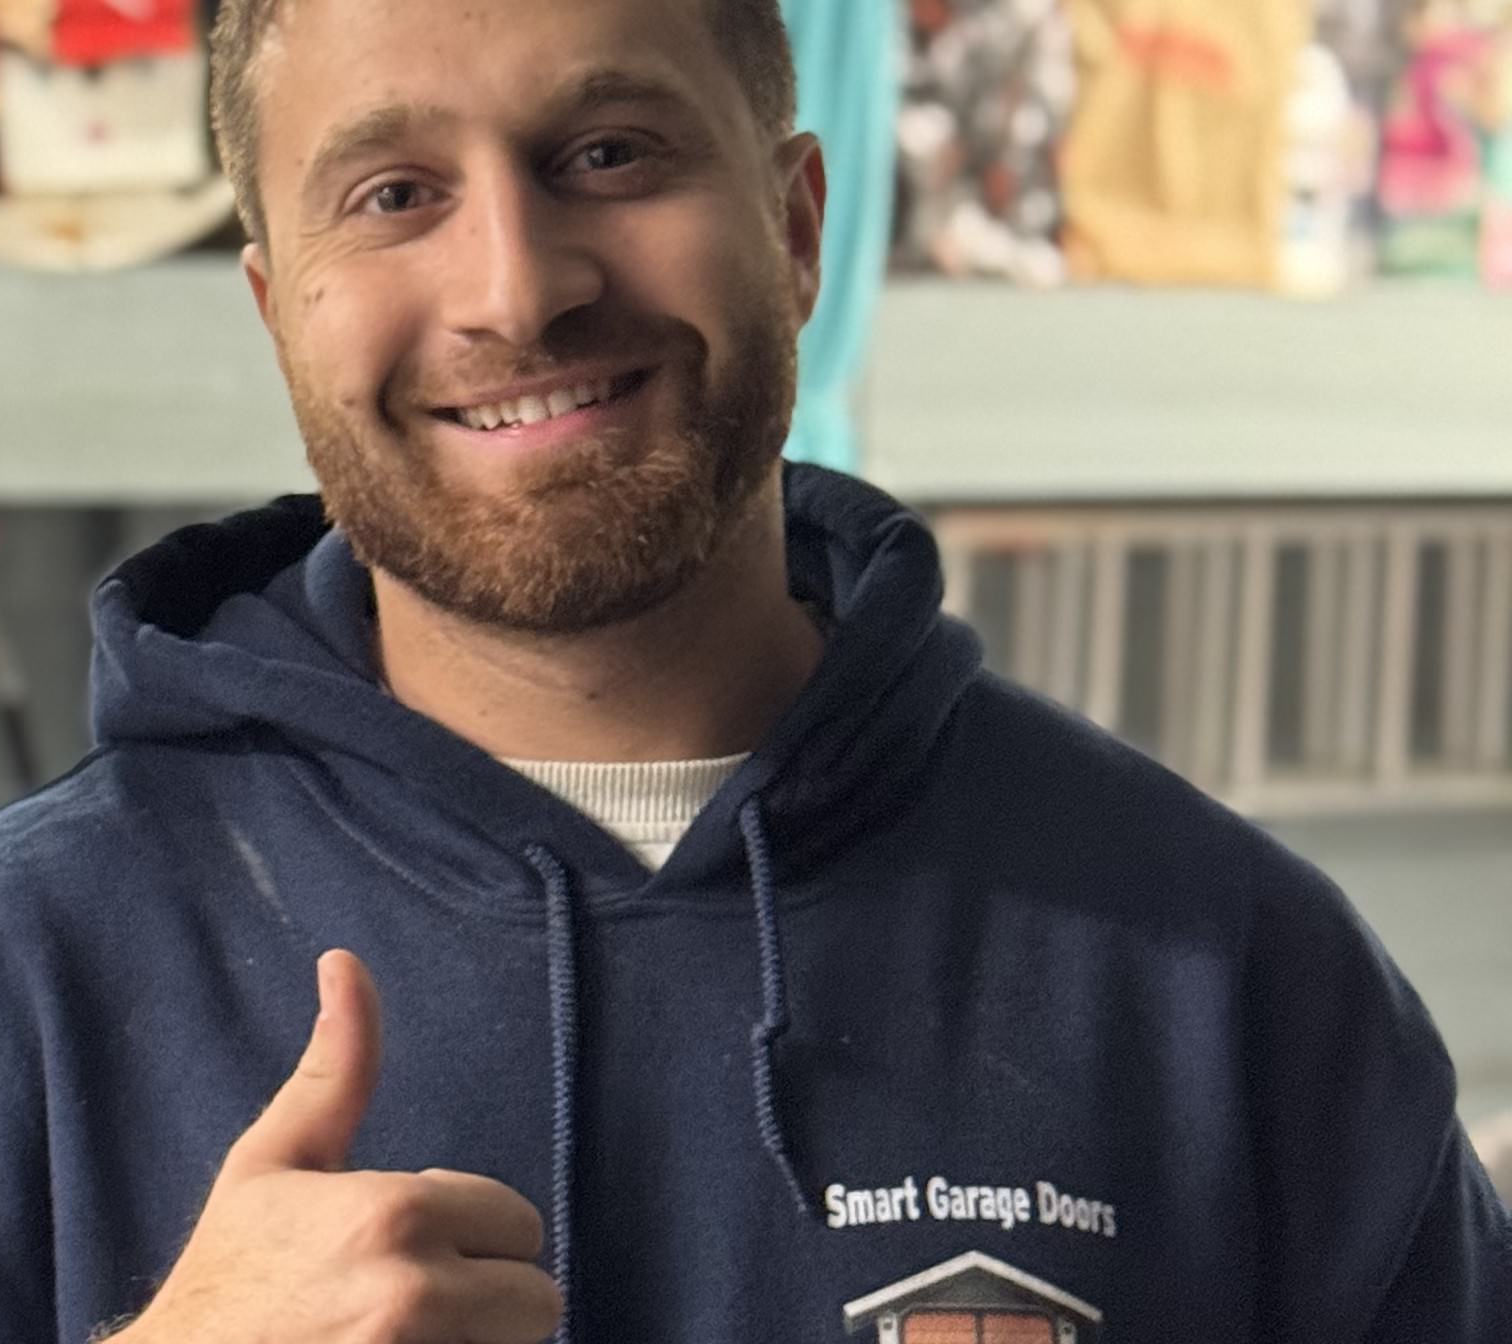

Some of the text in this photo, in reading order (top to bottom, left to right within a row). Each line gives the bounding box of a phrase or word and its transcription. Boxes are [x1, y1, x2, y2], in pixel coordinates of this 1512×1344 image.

[825, 1175, 1117, 1237] Smart Garage Doors
